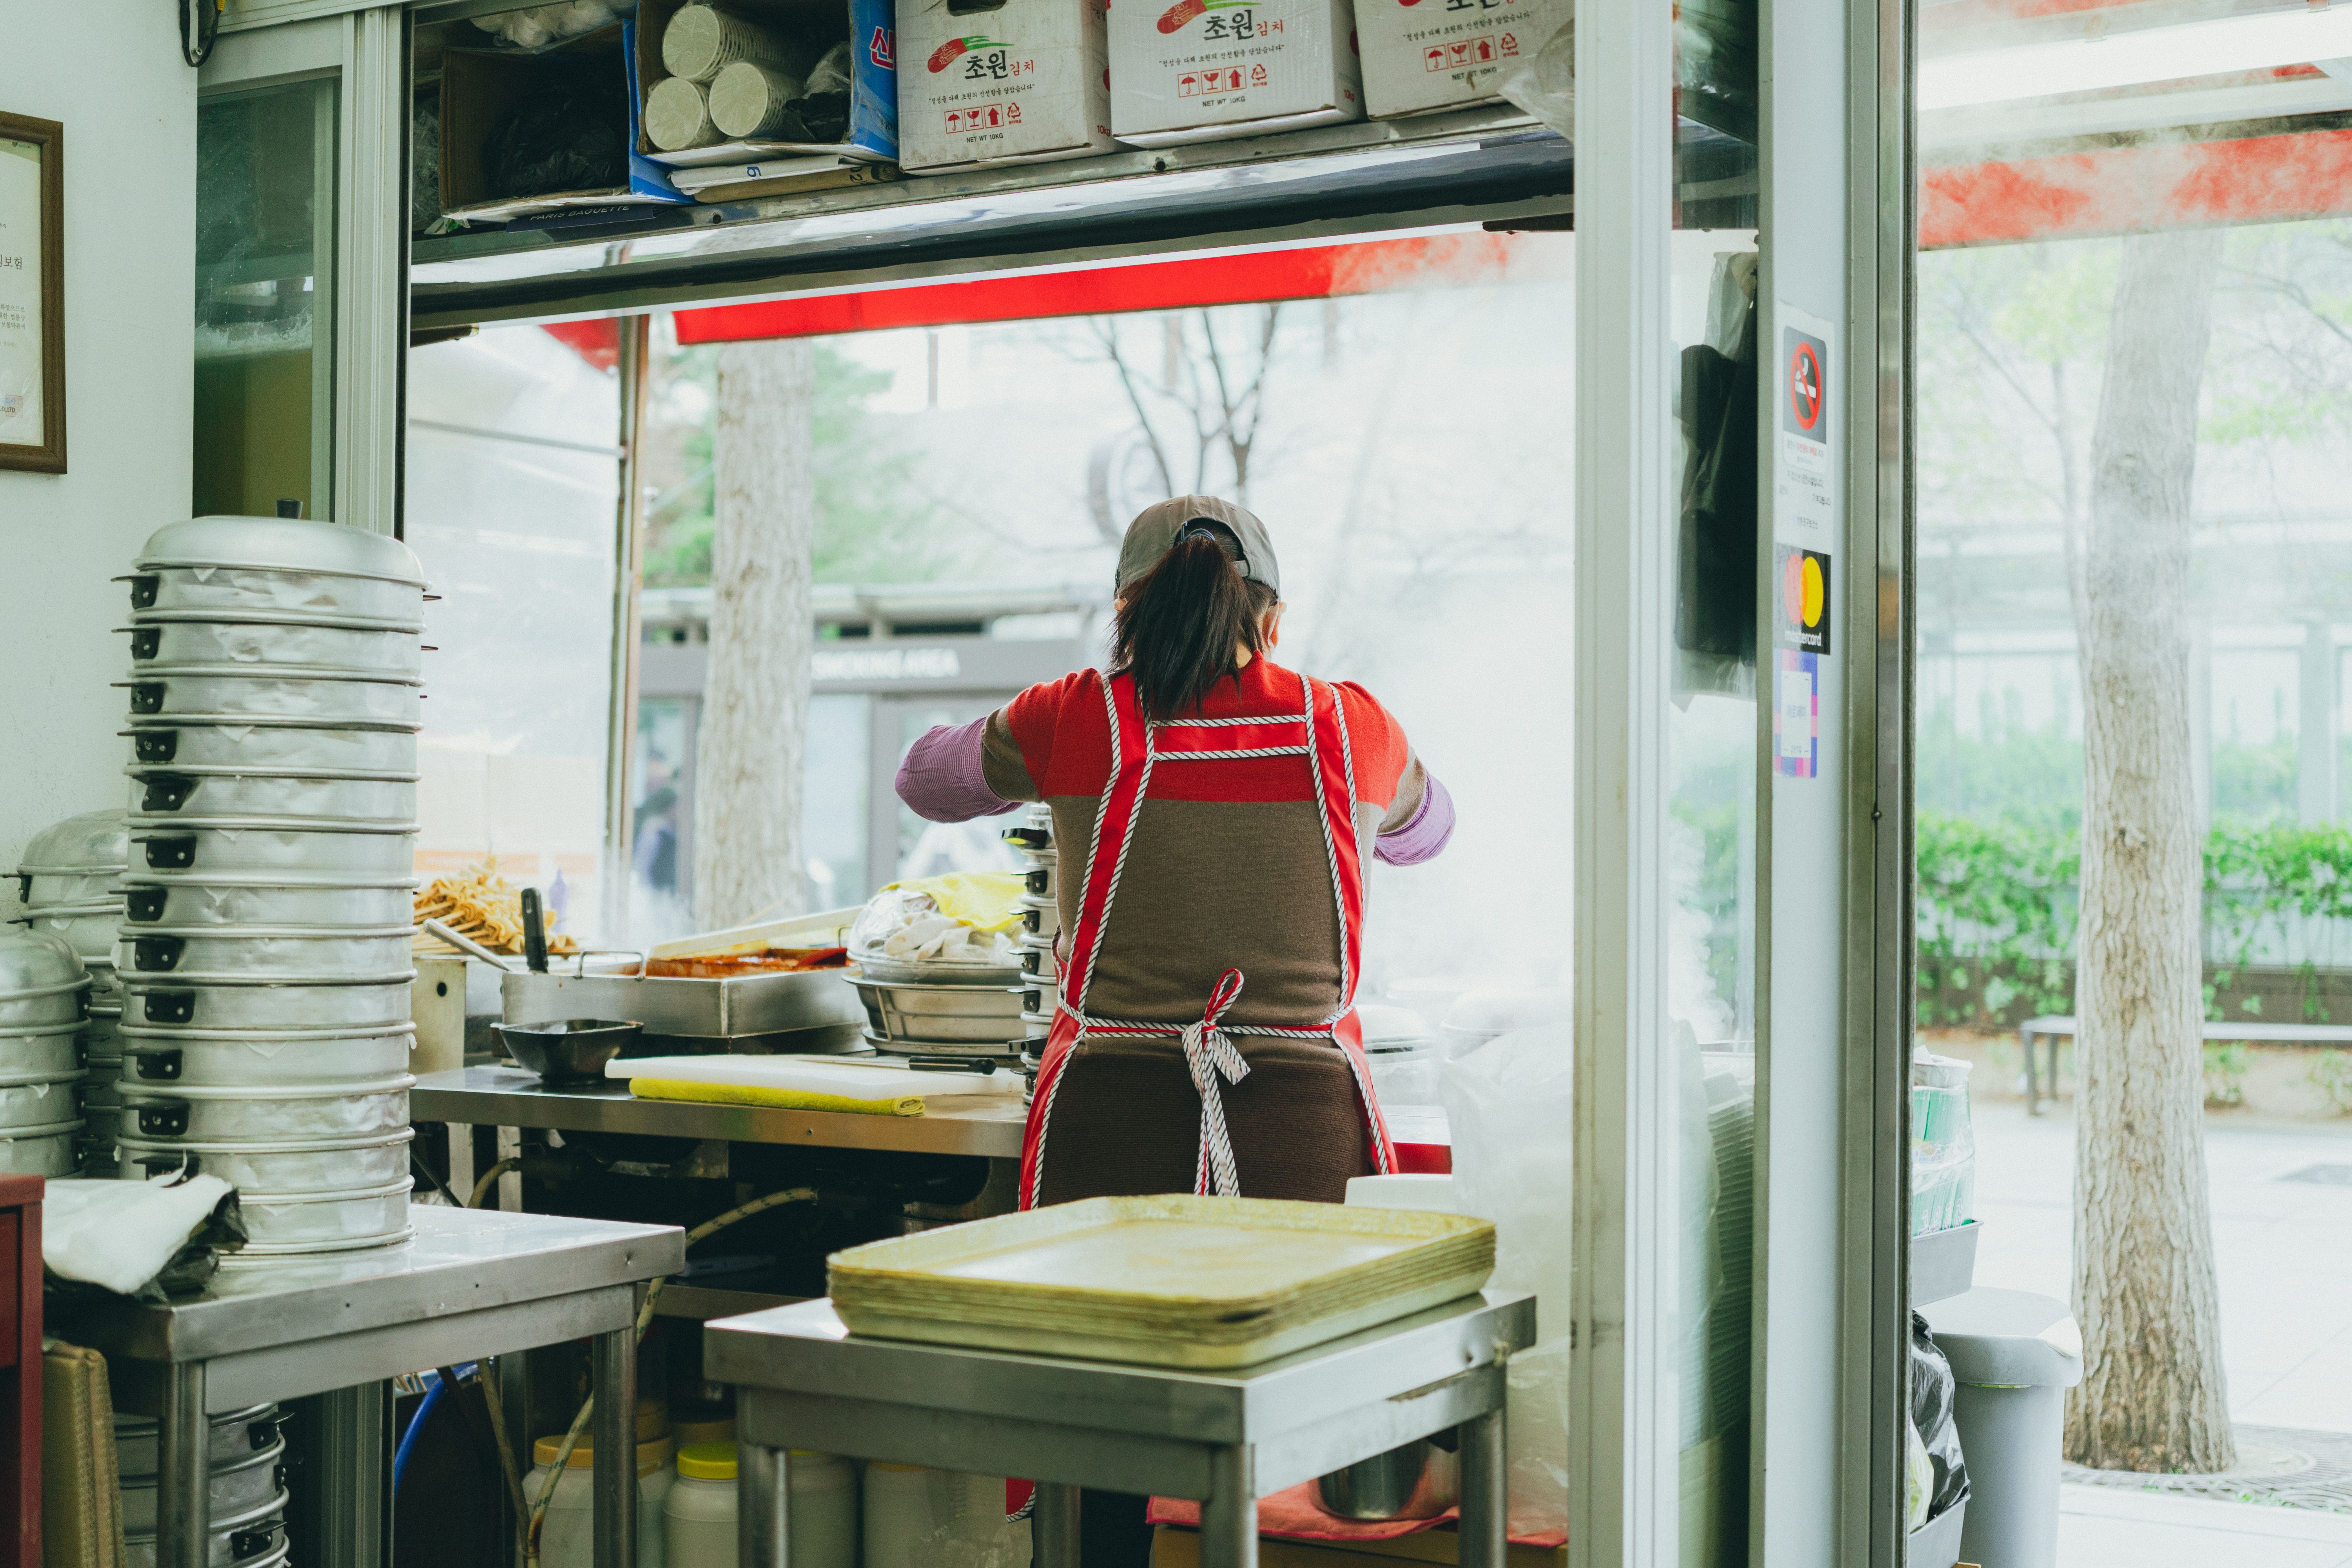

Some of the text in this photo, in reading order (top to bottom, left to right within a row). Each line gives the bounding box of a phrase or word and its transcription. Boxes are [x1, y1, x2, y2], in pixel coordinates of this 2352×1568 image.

[1203, 9, 1283, 40] 초원 김치
[1199, 53, 1217, 62] 초원의
[965, 50, 1034, 80] 초원 김치
[1452, 73, 1465, 81] NET
[1480, 66, 1497, 76] 10KG
[961, 92, 977, 100] 초원의
[979, 87, 1002, 98] 신선함을
[1343, 89, 1355, 102] 10kg
[1097, 125, 1111, 137] 10kg
[530, 205, 632, 220] PARIS BAGUETTE
